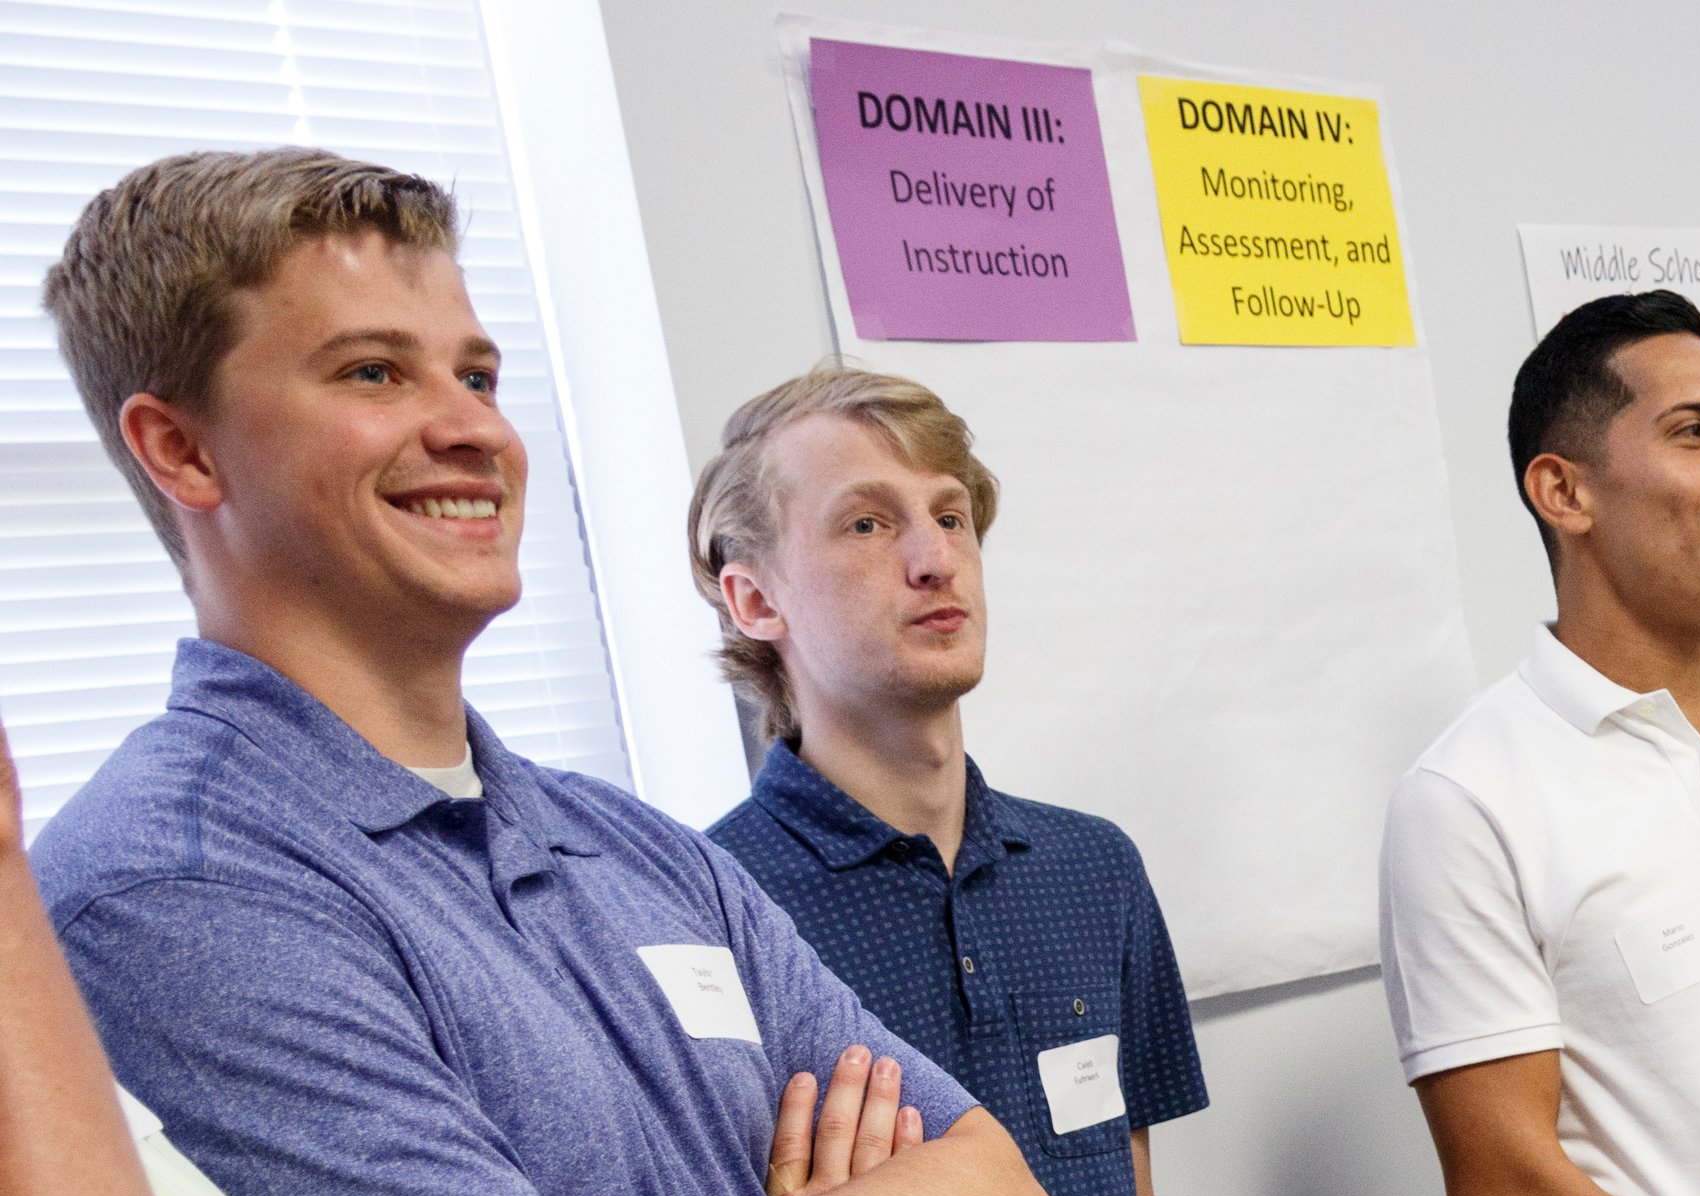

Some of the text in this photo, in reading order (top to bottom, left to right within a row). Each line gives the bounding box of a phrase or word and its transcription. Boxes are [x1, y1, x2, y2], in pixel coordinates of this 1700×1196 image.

[858, 90, 1065, 144] DOMAIN III:
[1178, 96, 1353, 145] DOMAIN IV:
[890, 169, 1055, 217] Delivery of
[1201, 166, 1353, 212] Monitoring,
[903, 240, 1068, 277] Instruction
[1180, 225, 1391, 267] Assessment, and
[1560, 244, 1641, 283] Middle
[1232, 285, 1361, 325] Follow-Up
